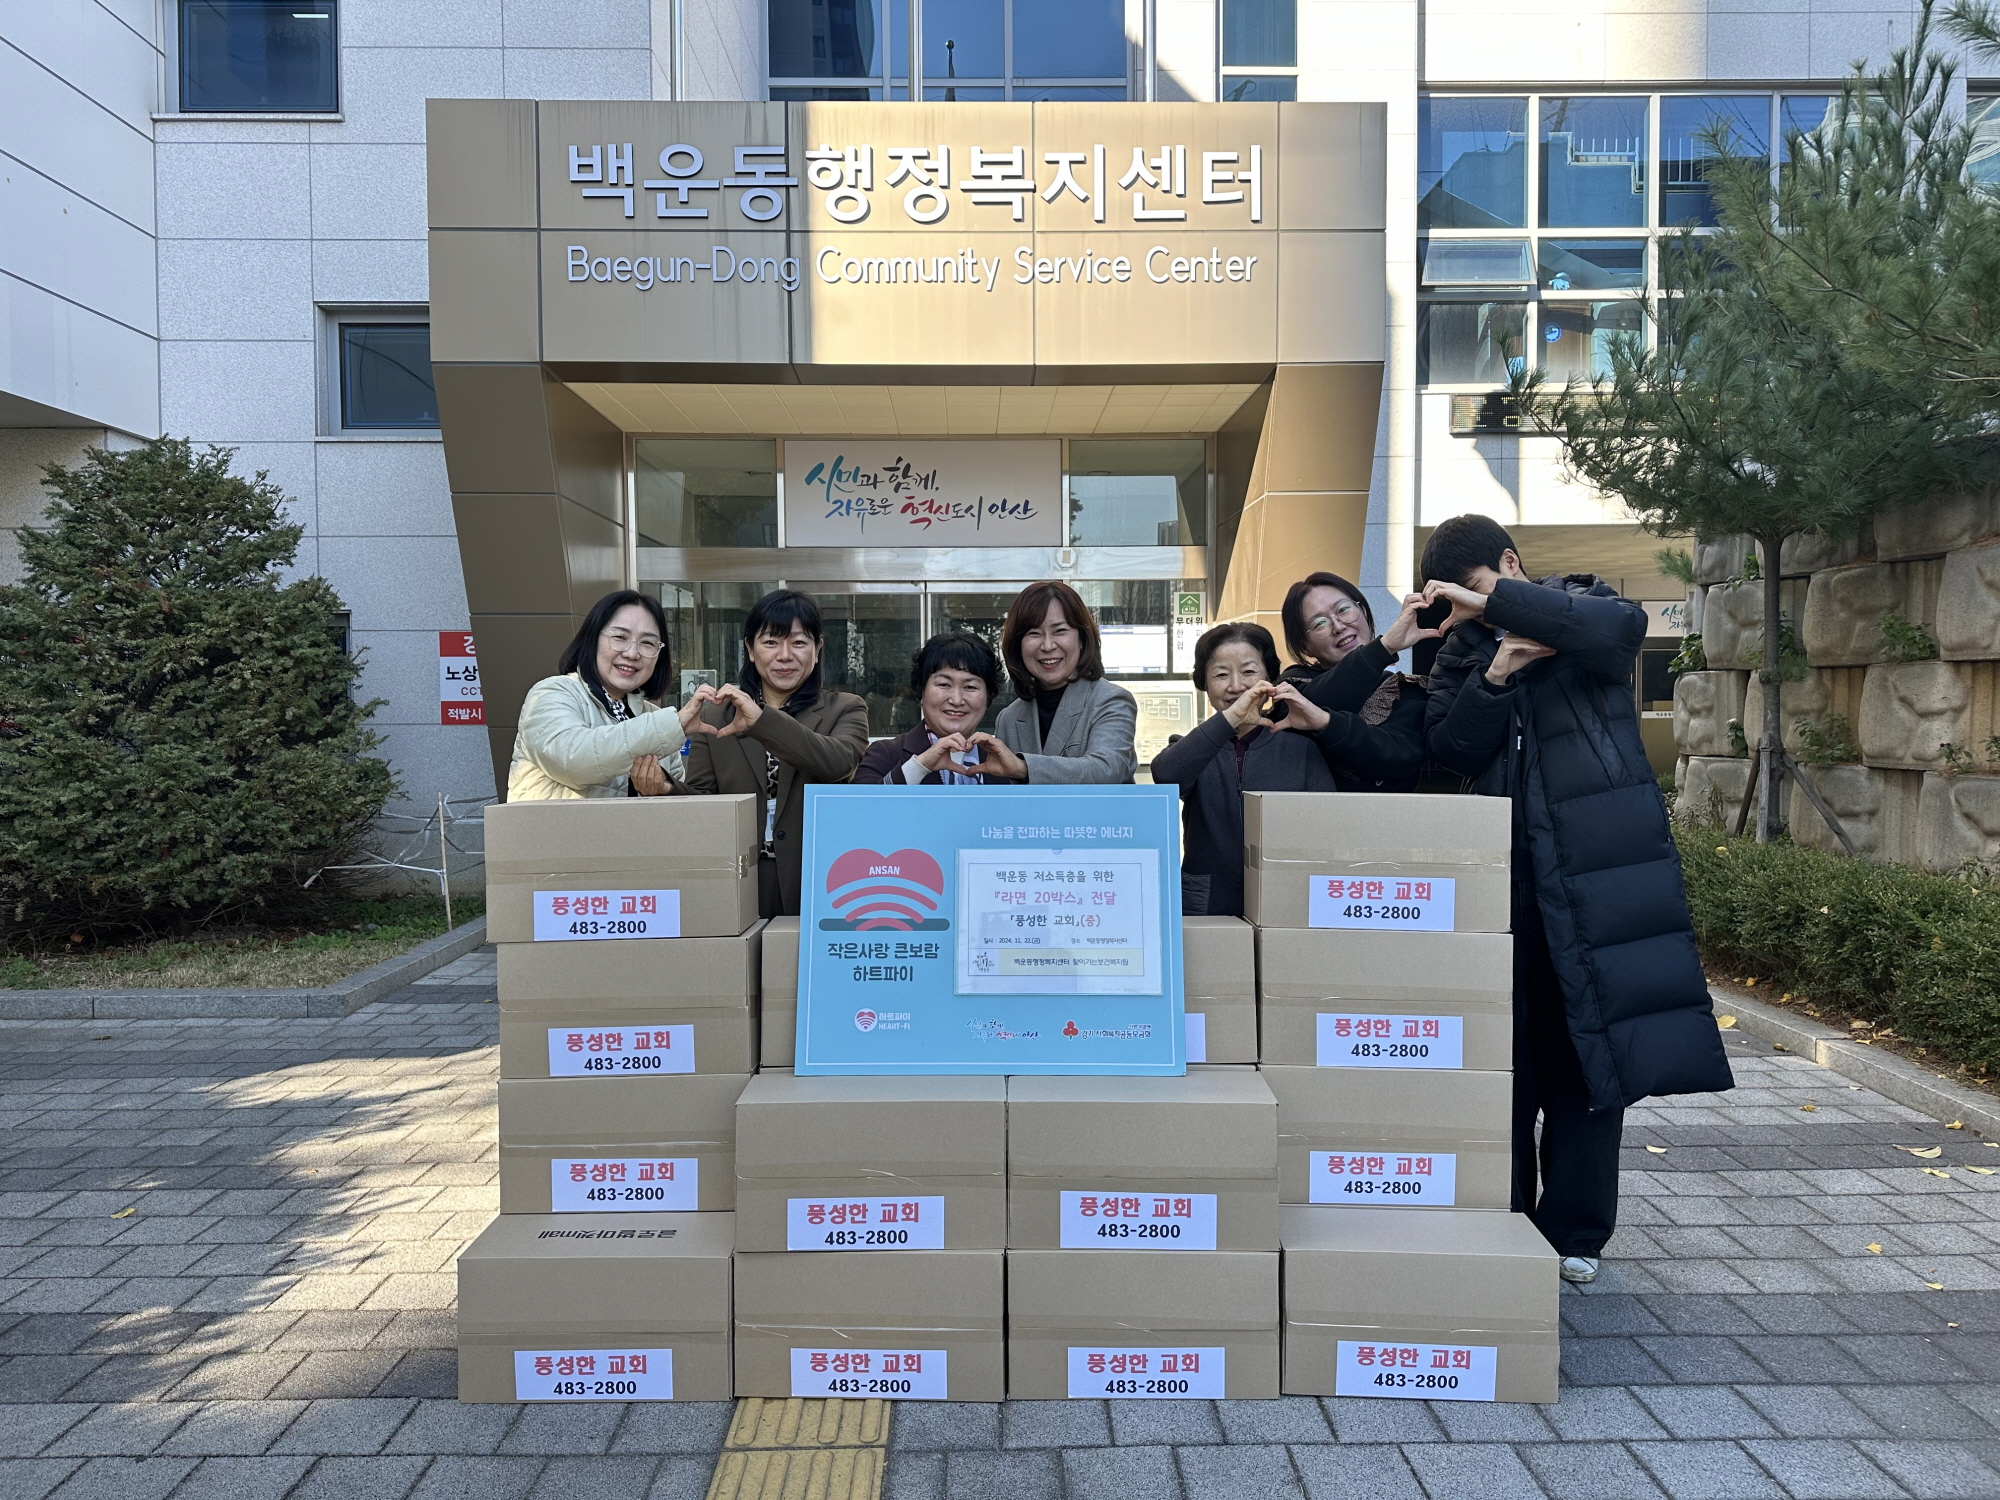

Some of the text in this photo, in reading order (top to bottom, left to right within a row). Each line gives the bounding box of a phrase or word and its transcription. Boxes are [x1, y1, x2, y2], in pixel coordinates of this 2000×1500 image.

[568, 142, 1262, 224] 백운동행정복지센터
[566, 245, 1257, 291] Baegun-Dong Community Service Center
[804, 455, 884, 502] 시민과
[825, 495, 1039, 534] 자유로운 혁신도시 안산
[1176, 616, 1203, 626] 무더위
[447, 707, 482, 720] 적발시
[981, 825, 1133, 840] 나눔을 전파하는 따뜻한 에너지
[868, 866, 901, 876] ANSAN
[996, 870, 1115, 883] 백운동 저소득층을 위한
[1328, 881, 1431, 900] 풍성한 교회
[552, 896, 656, 915] 풍성한 교회
[994, 891, 1117, 906] 『라면 20박스』 전달
[1343, 905, 1421, 920] 483-2800
[569, 920, 647, 935] 483-2800
[1010, 915, 1047, 927] 「풍성한
[827, 942, 940, 960] 작은사랑 큰보람
[1013, 957, 1070, 966] 백운동행정복지센터
[853, 965, 914, 982] 하트파이
[878, 1012, 911, 1022] 하트파이
[878, 1022, 911, 1030] HEART-FI
[1335, 1018, 1439, 1038] 풍성한 교회
[566, 1031, 670, 1052] 풍성한 교회
[1351, 1043, 1429, 1058] 483-2800
[584, 1056, 661, 1071] 483-2800
[570, 1162, 674, 1182] 풍성한 교회
[1328, 1156, 1432, 1175] 풍성한 교회
[586, 1187, 665, 1202] 483-2800
[1344, 1180, 1422, 1195] 483-2800
[807, 1203, 919, 1225] 풍성한 교회
[1080, 1197, 1192, 1218] 풍성한 교회
[538, 1229, 677, 1239] 글로벌마켓mall
[824, 1229, 908, 1245] 483-2800
[1097, 1223, 1181, 1238] 483-2800
[534, 1355, 648, 1375] 풍성한 교회
[810, 1353, 922, 1373] 풍성한 교회
[1087, 1353, 1200, 1373] 풍성한 교회
[1357, 1346, 1471, 1369] 풍성한 교회
[553, 1381, 637, 1395] 483-2800
[827, 1379, 911, 1394] 483-2800
[1105, 1380, 1189, 1393] 483-2800
[1373, 1373, 1459, 1389] 483-2800
